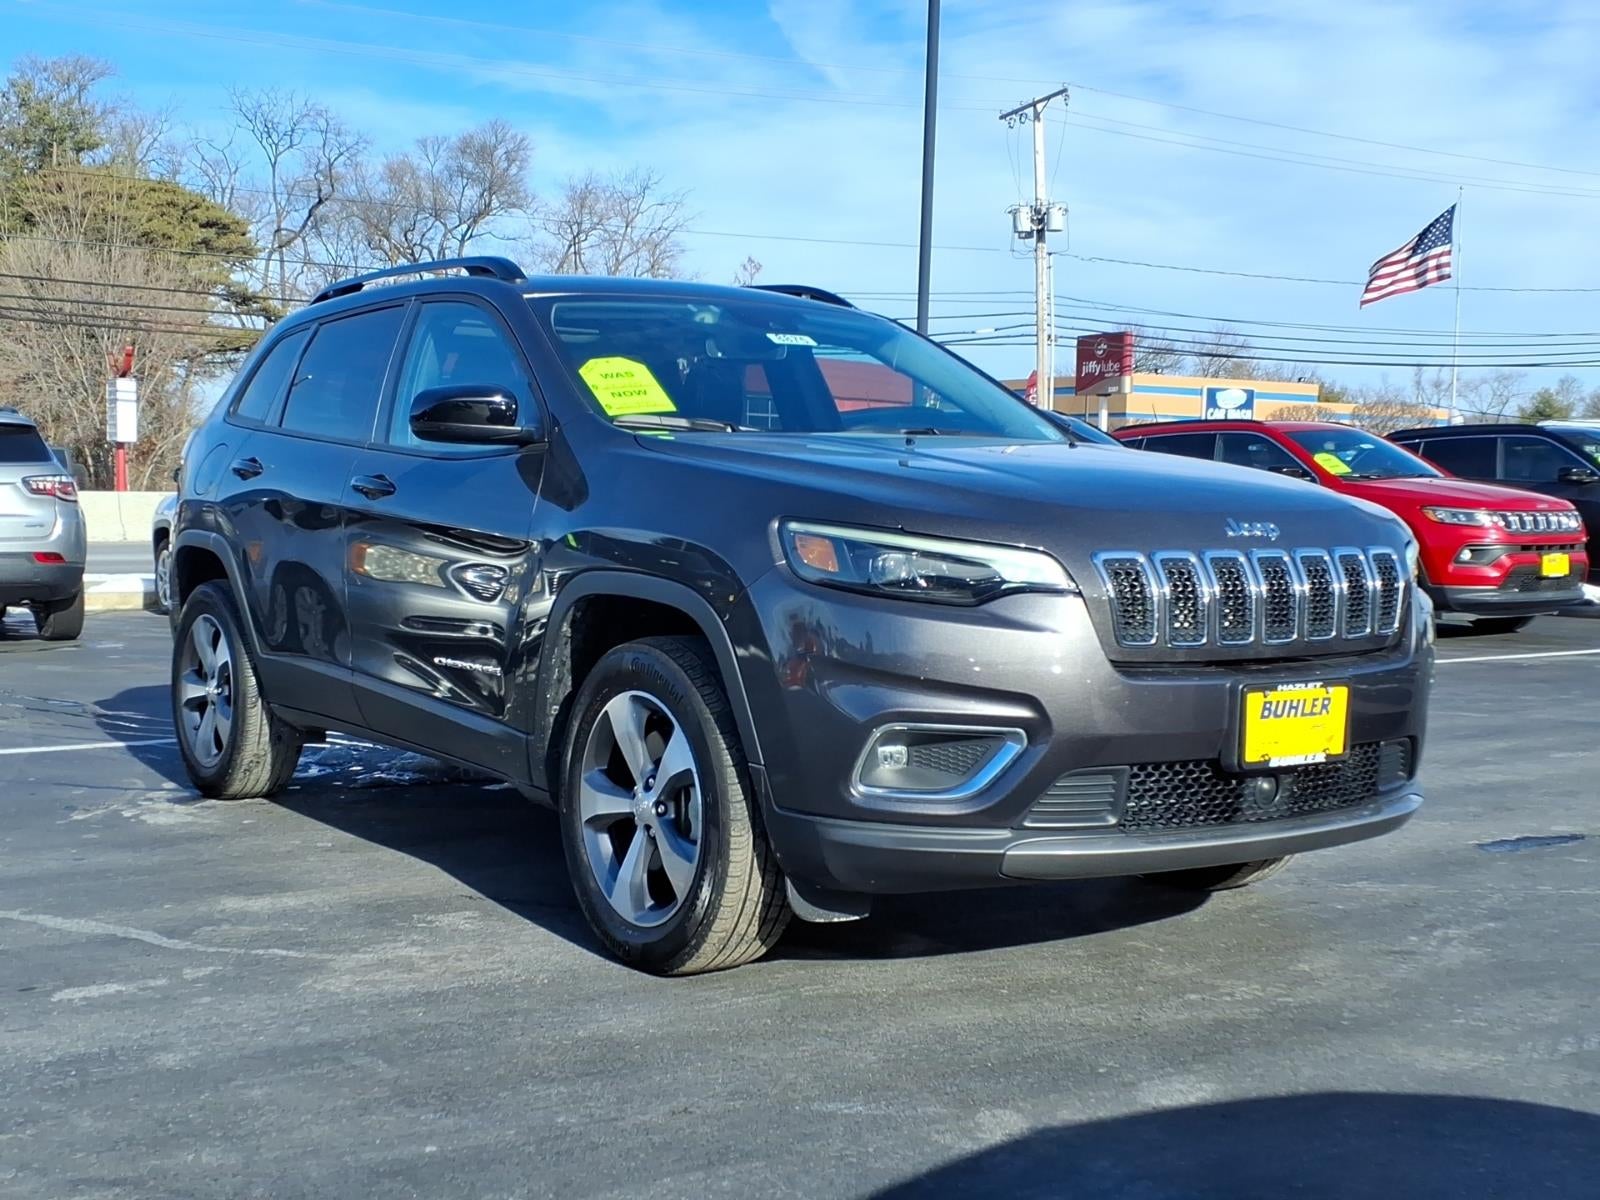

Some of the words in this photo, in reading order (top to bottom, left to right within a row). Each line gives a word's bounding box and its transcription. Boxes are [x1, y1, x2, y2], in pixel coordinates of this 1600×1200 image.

[600, 371, 635, 380] WAS
[1081, 360, 1101, 377] jiffy
[1101, 359, 1121, 373] lube
[610, 389, 648, 399] NOW
[1224, 518, 1281, 541] Jeep
[1259, 697, 1332, 720] BUHLER
